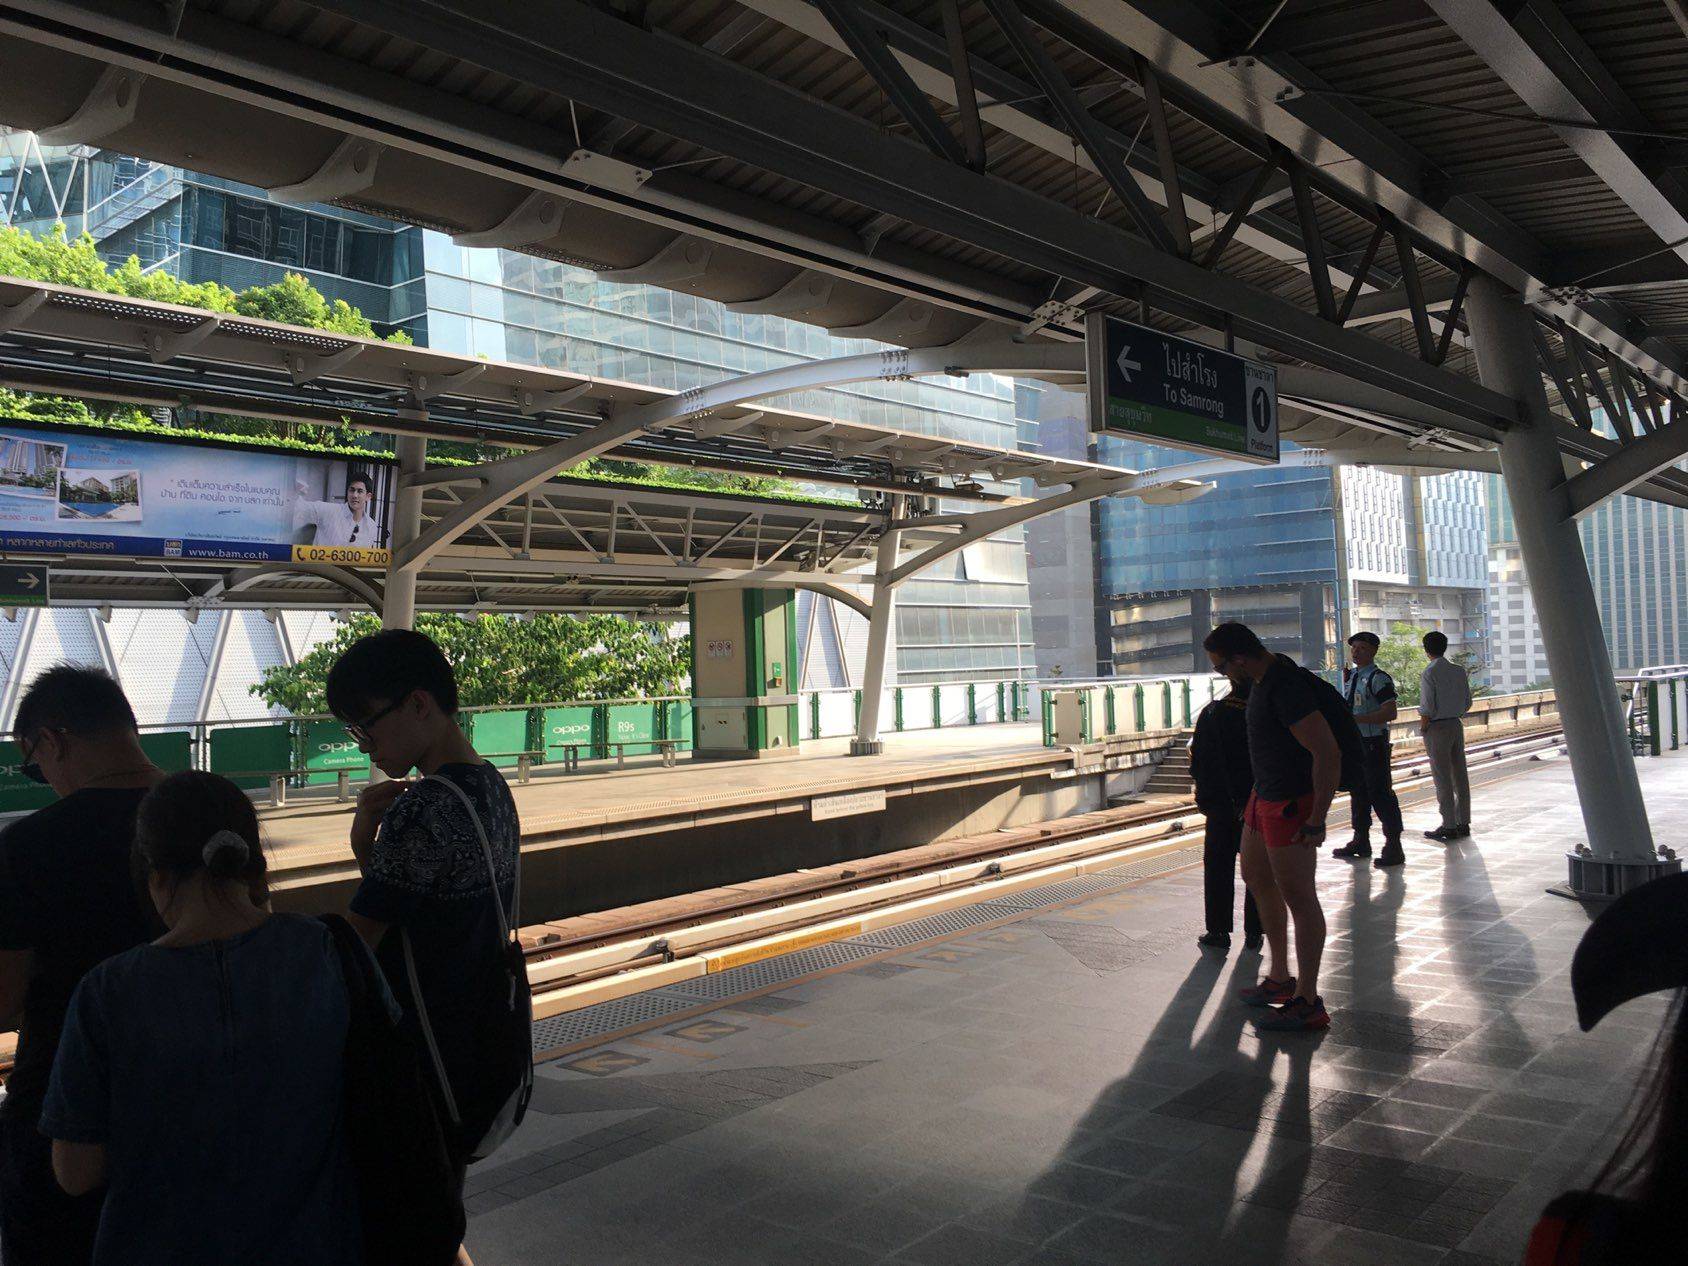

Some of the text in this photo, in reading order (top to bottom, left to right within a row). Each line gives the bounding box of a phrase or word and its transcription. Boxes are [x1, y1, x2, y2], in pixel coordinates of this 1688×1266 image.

[1162, 341, 1218, 389] ไปสำโรง
[1163, 384, 1225, 418] To Samrong
[189, 548, 270, 561] www.bam.co.th
[309, 550, 389, 564] 02-6300-700
[618, 721, 635, 733] R9s
